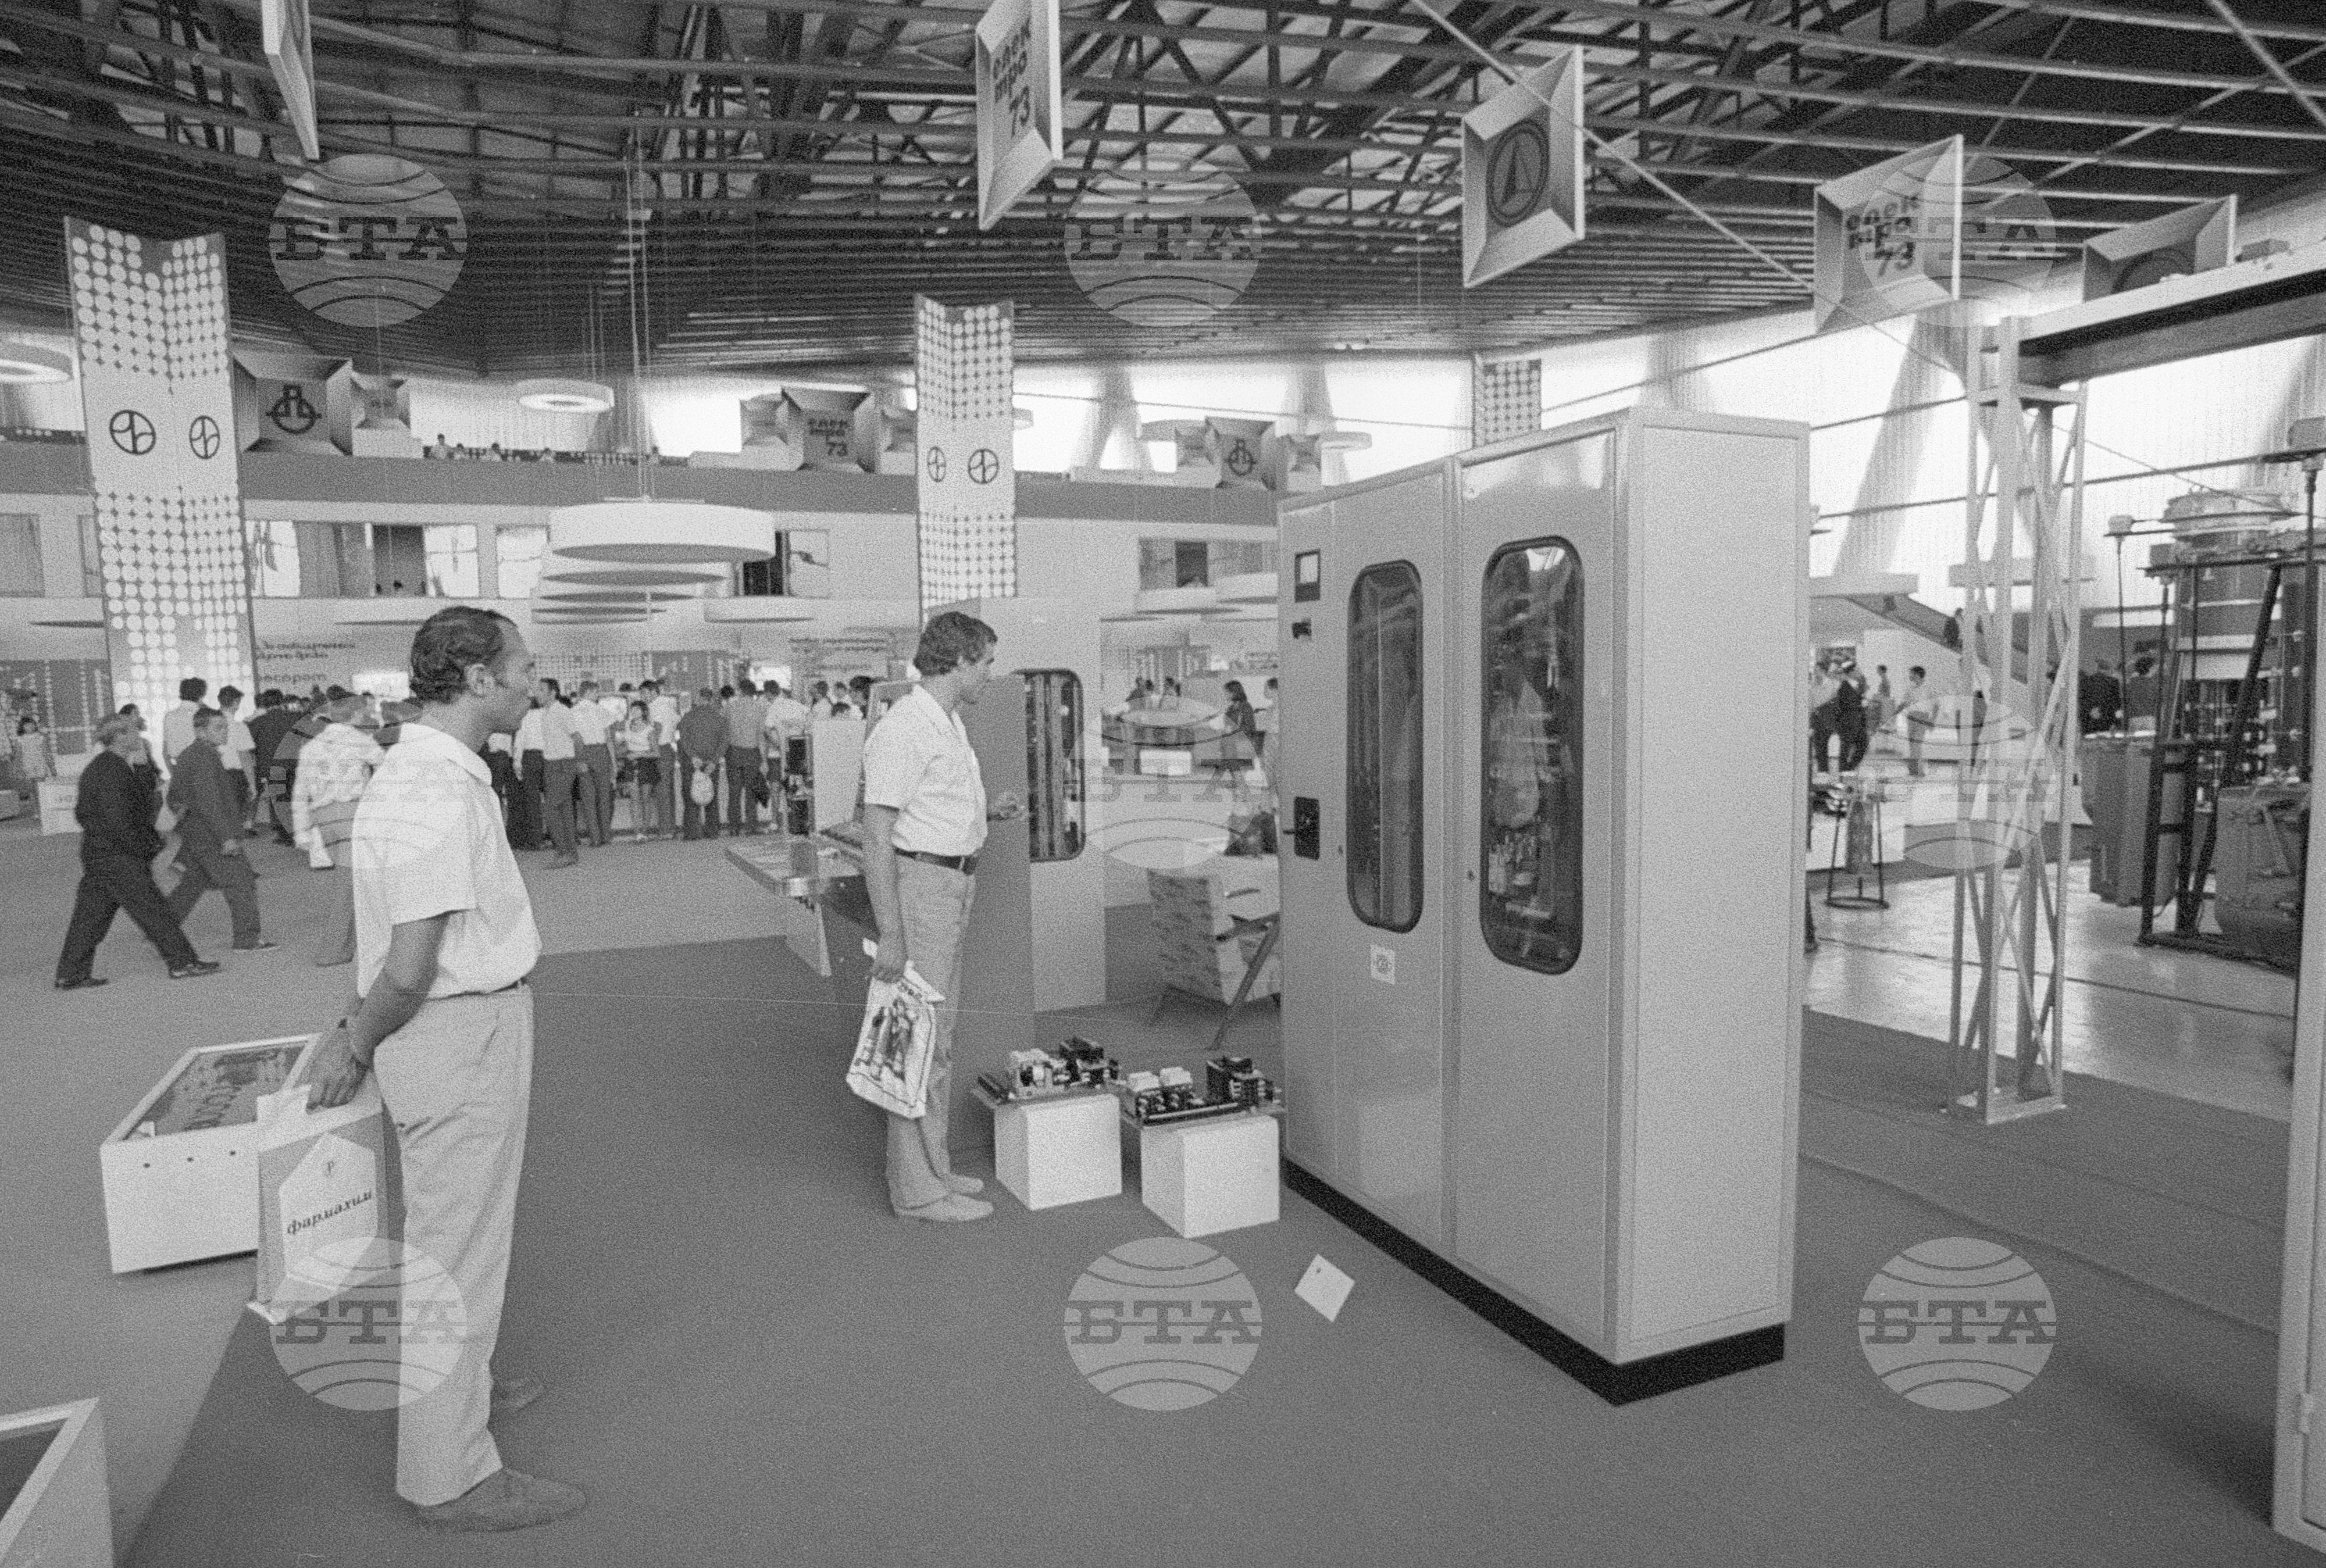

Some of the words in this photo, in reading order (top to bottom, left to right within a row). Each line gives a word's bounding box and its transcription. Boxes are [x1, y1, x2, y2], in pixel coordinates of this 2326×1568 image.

[1009, 85, 1030, 138] 73
[1874, 237, 1915, 276] 73
[826, 442, 848, 456] 73
